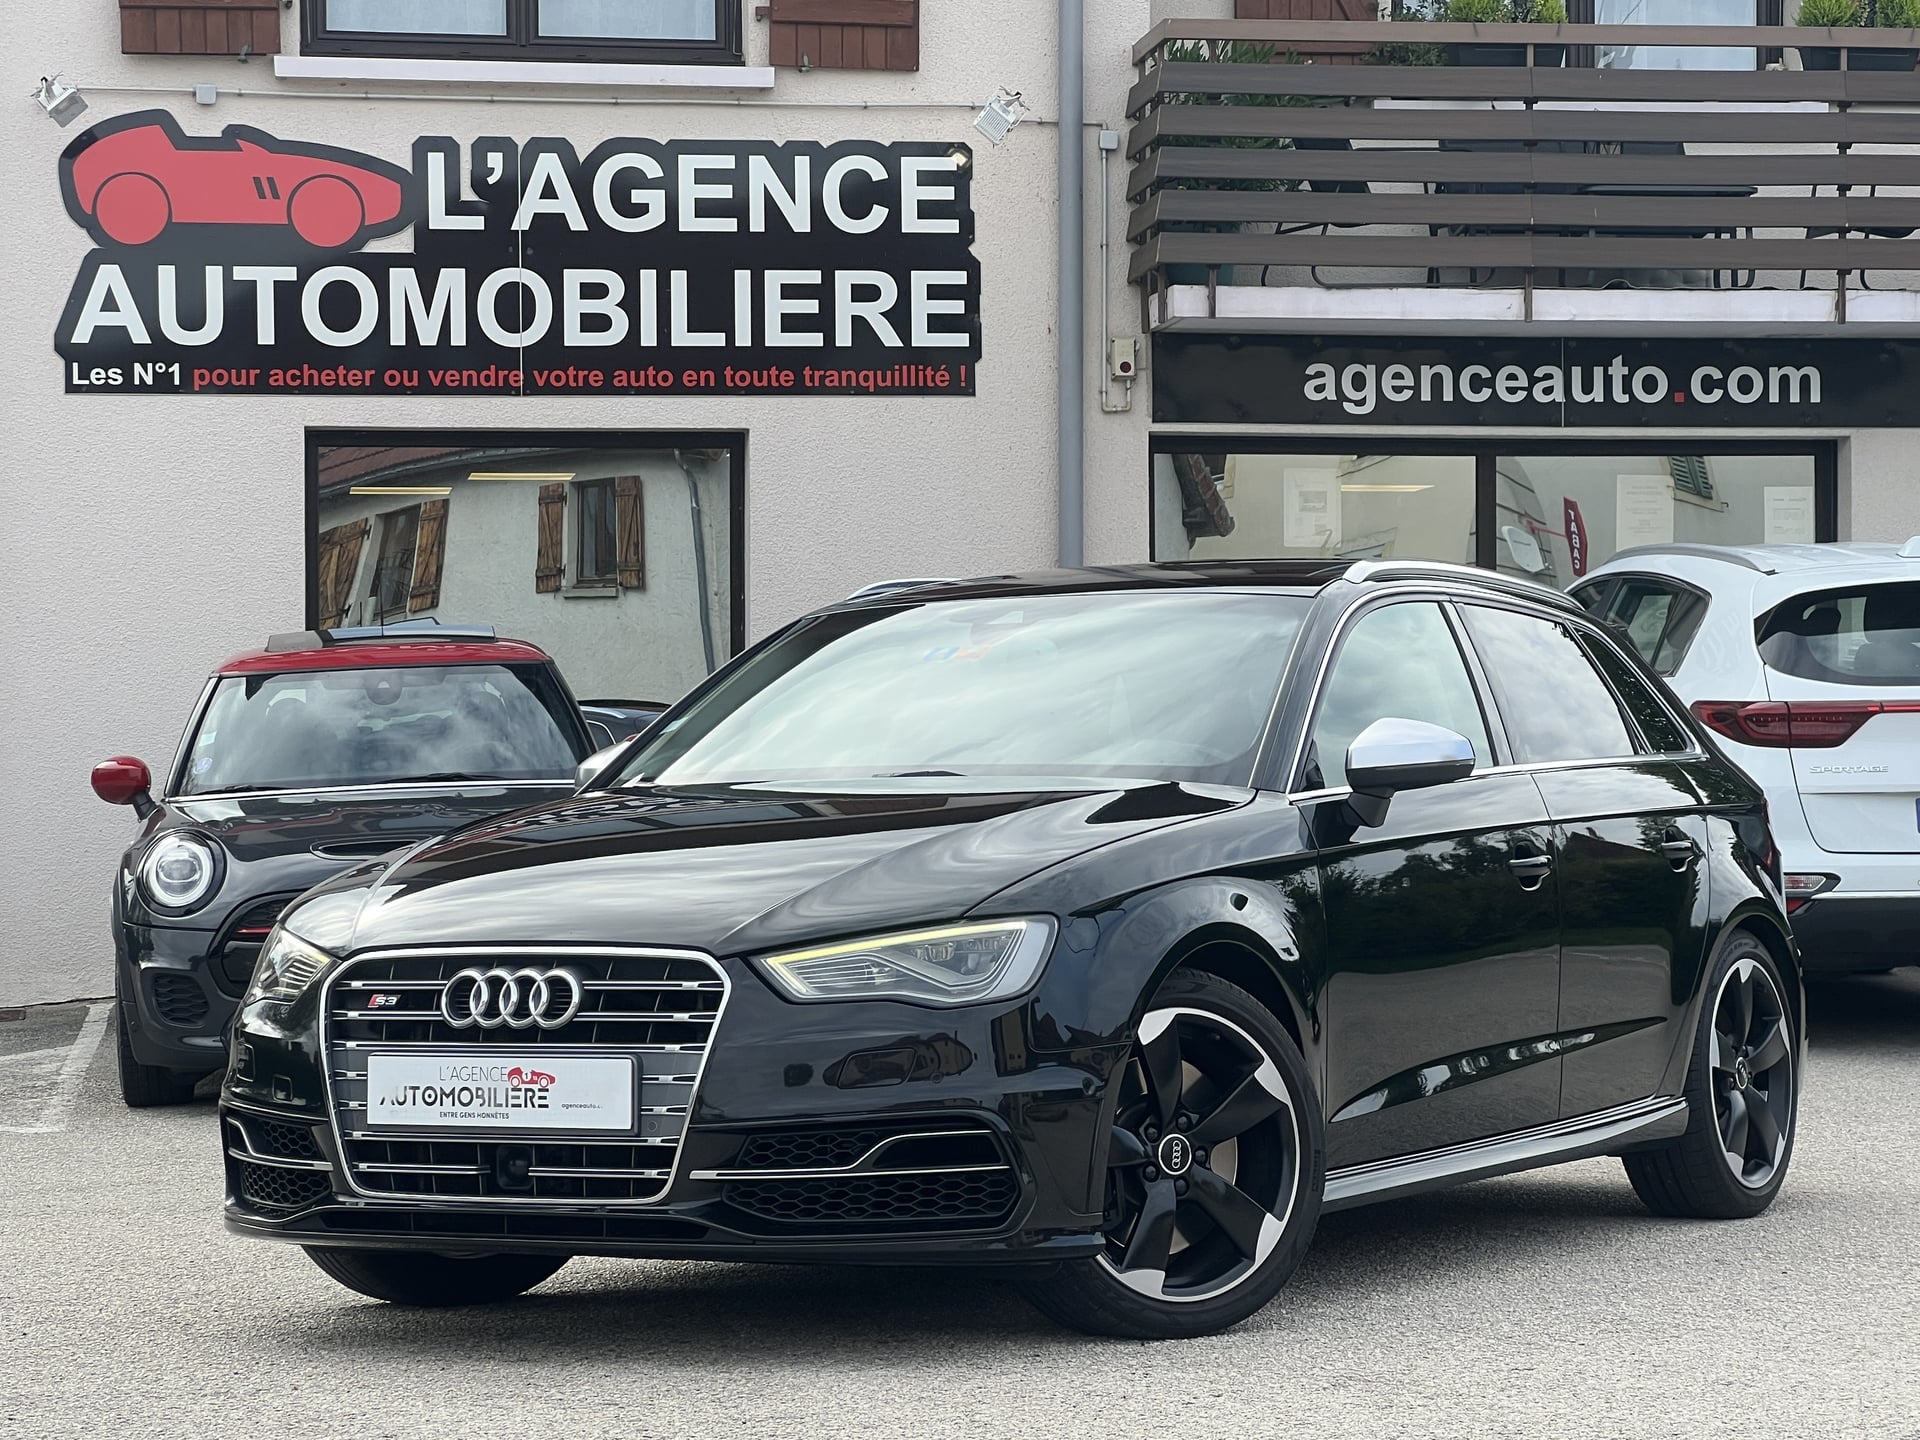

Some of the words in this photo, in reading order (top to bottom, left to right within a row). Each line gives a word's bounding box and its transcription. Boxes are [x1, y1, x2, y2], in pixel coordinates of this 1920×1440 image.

[428, 152, 960, 234] L'AGENCE
[70, 264, 970, 348] AUTOMOBILIERE
[72, 363, 124, 385] Les
[133, 362, 181, 385] N°1
[193, 368, 260, 391] pour
[268, 363, 375, 387] acheter
[383, 369, 419, 387] ou
[428, 366, 523, 387] vendre
[533, 367, 604, 387] votre
[613, 367, 674, 387] auto
[682, 370, 715, 387] en
[724, 366, 796, 387] toute
[803, 364, 951, 391] tranquillité
[1304, 354, 1822, 414] agenceauto.com
[1809, 765, 1889, 774] SPORTAGE
[371, 994, 399, 1007] S3
[439, 1065, 508, 1082] L'AGENCE
[440, 1111, 458, 1119] ENTRE
